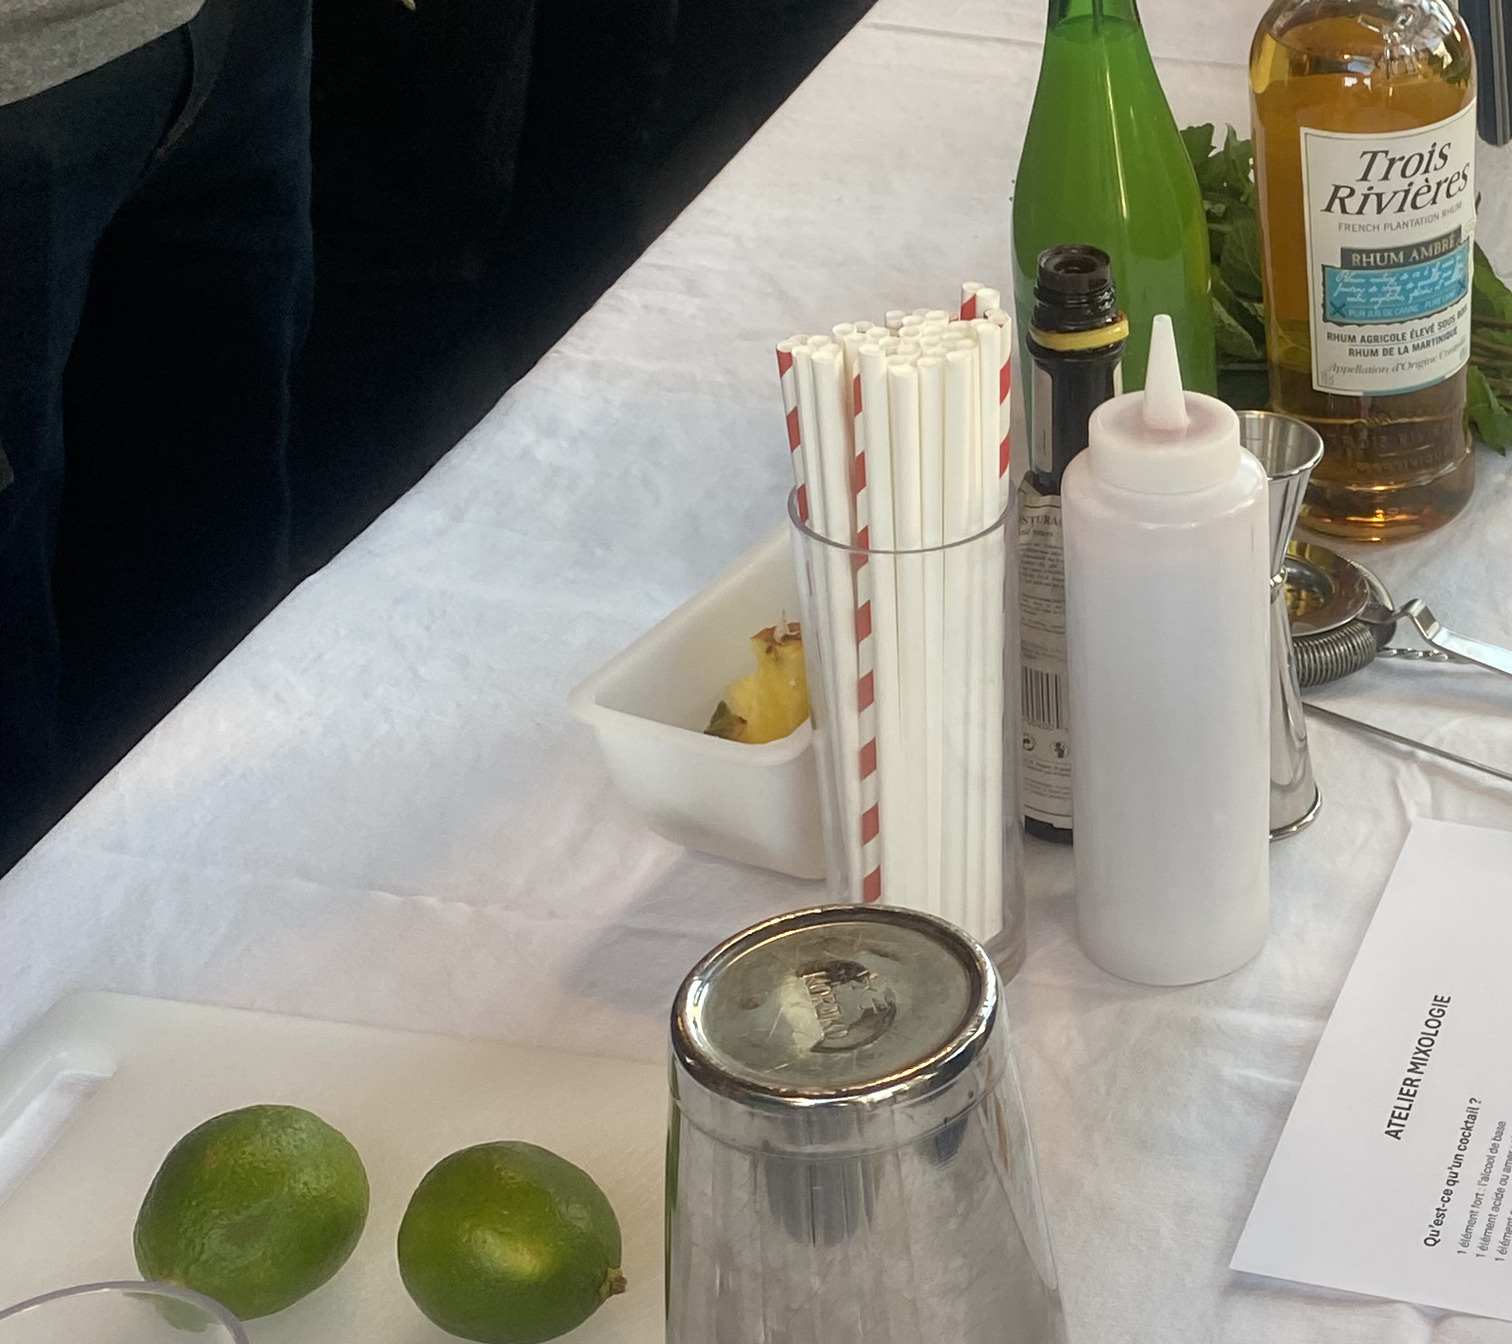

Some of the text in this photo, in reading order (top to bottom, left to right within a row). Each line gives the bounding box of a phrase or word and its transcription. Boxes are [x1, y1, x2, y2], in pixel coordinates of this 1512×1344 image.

[1355, 141, 1452, 183] Trois
[1320, 162, 1470, 216] Rivières
[1338, 222, 1380, 233] FRENCH
[1383, 214, 1440, 232] PLANTATION
[1351, 250, 1404, 268] RHUM
[1326, 332, 1357, 344] RHUM
[1359, 331, 1407, 344] AGRICOLE
[1409, 322, 1435, 340] ÉLEVÉ
[1348, 346, 1379, 358] RHUM
[1382, 346, 1395, 357] DE
[1397, 343, 1410, 356] LA
[1411, 326, 1459, 353] MARTINIQUE
[1384, 994, 1452, 1141] ATELIER MIXOLOGIE
[1456, 1106, 1480, 1152] cocktail
[1468, 1097, 1482, 1105] ?
[1490, 1120, 1507, 1143] base
[1488, 1142, 1501, 1155] de
[1470, 1192, 1486, 1209] fort
[1458, 1209, 1480, 1249] élément
[1476, 1213, 1499, 1252] élément
[1490, 1186, 1506, 1213] acide
